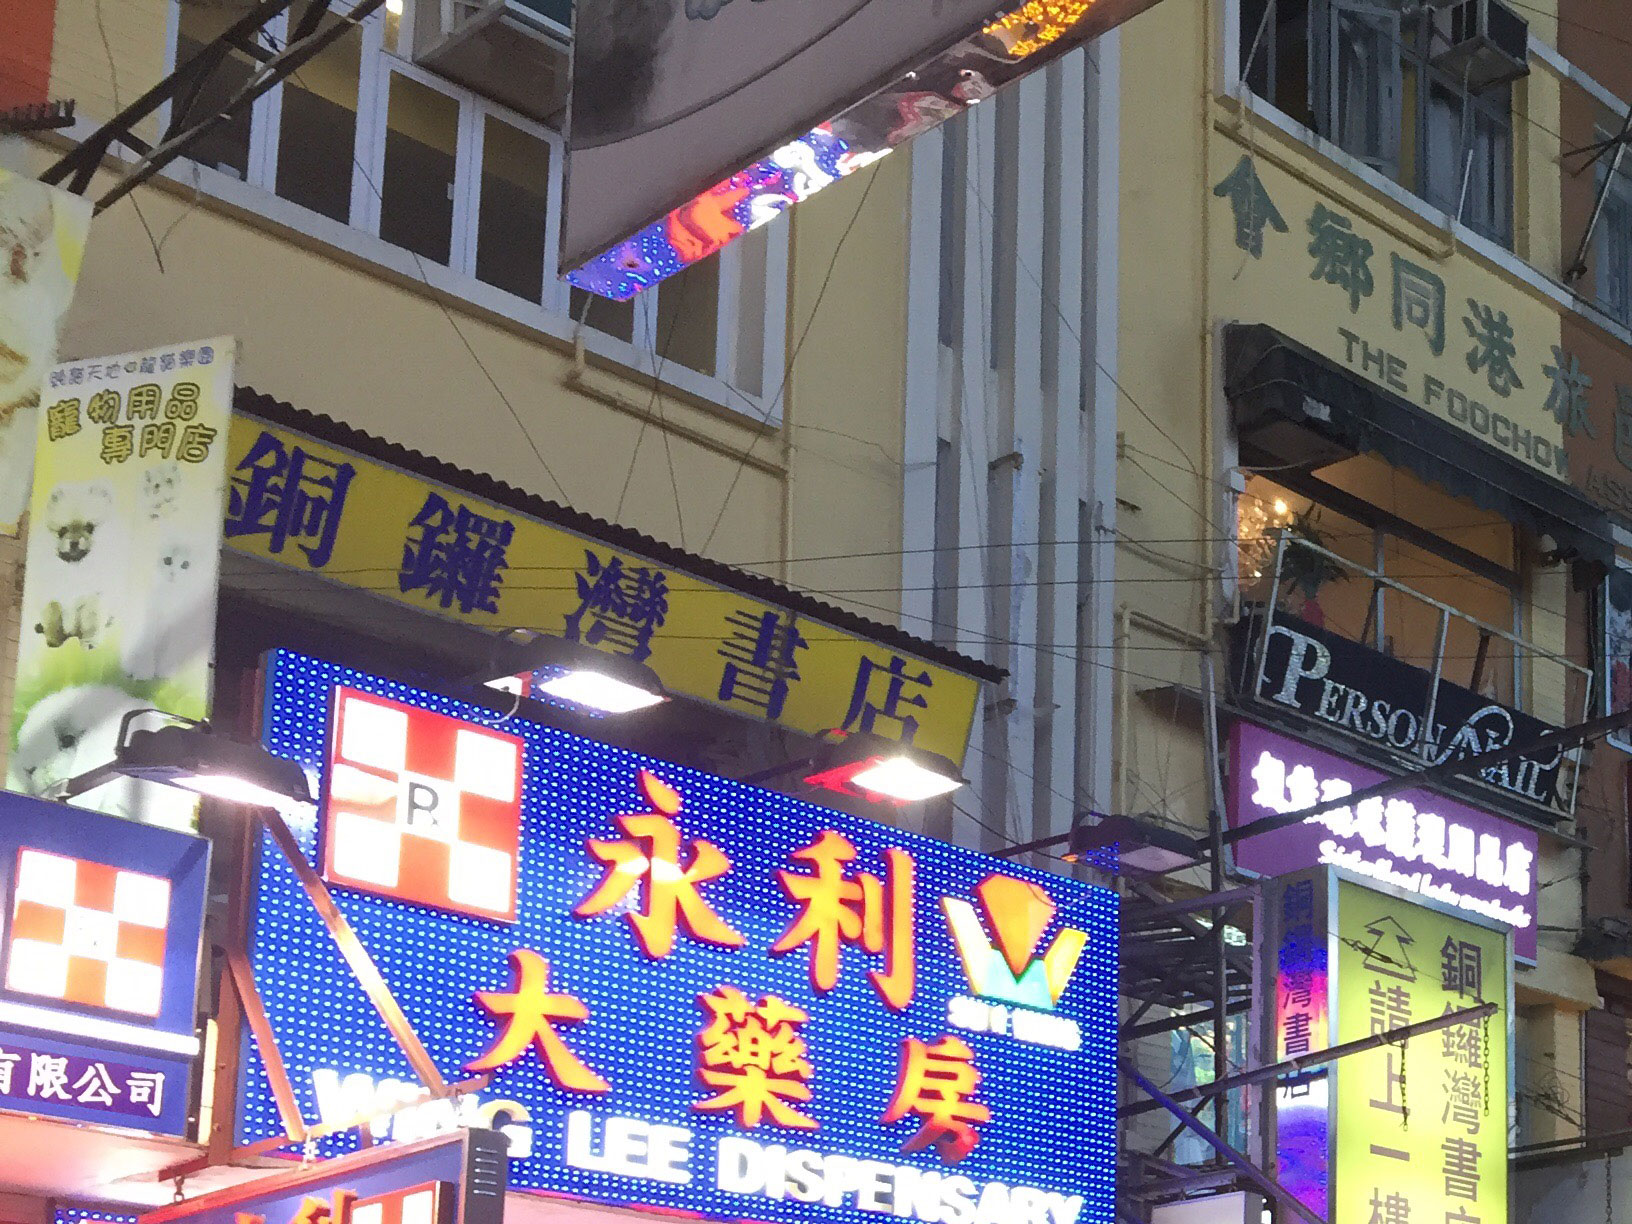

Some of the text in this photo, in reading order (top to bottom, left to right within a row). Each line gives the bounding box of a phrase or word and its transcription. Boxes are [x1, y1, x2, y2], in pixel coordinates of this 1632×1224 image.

[1337, 326, 1408, 392] THE
[47, 382, 201, 442] 寵物用品
[100, 422, 217, 464] 專門店
[224, 430, 935, 748] 銅鑼灣書店
[573, 768, 919, 1011] 永利
[462, 948, 992, 1166] 大藥房
[567, 1111, 692, 1184] LEE
